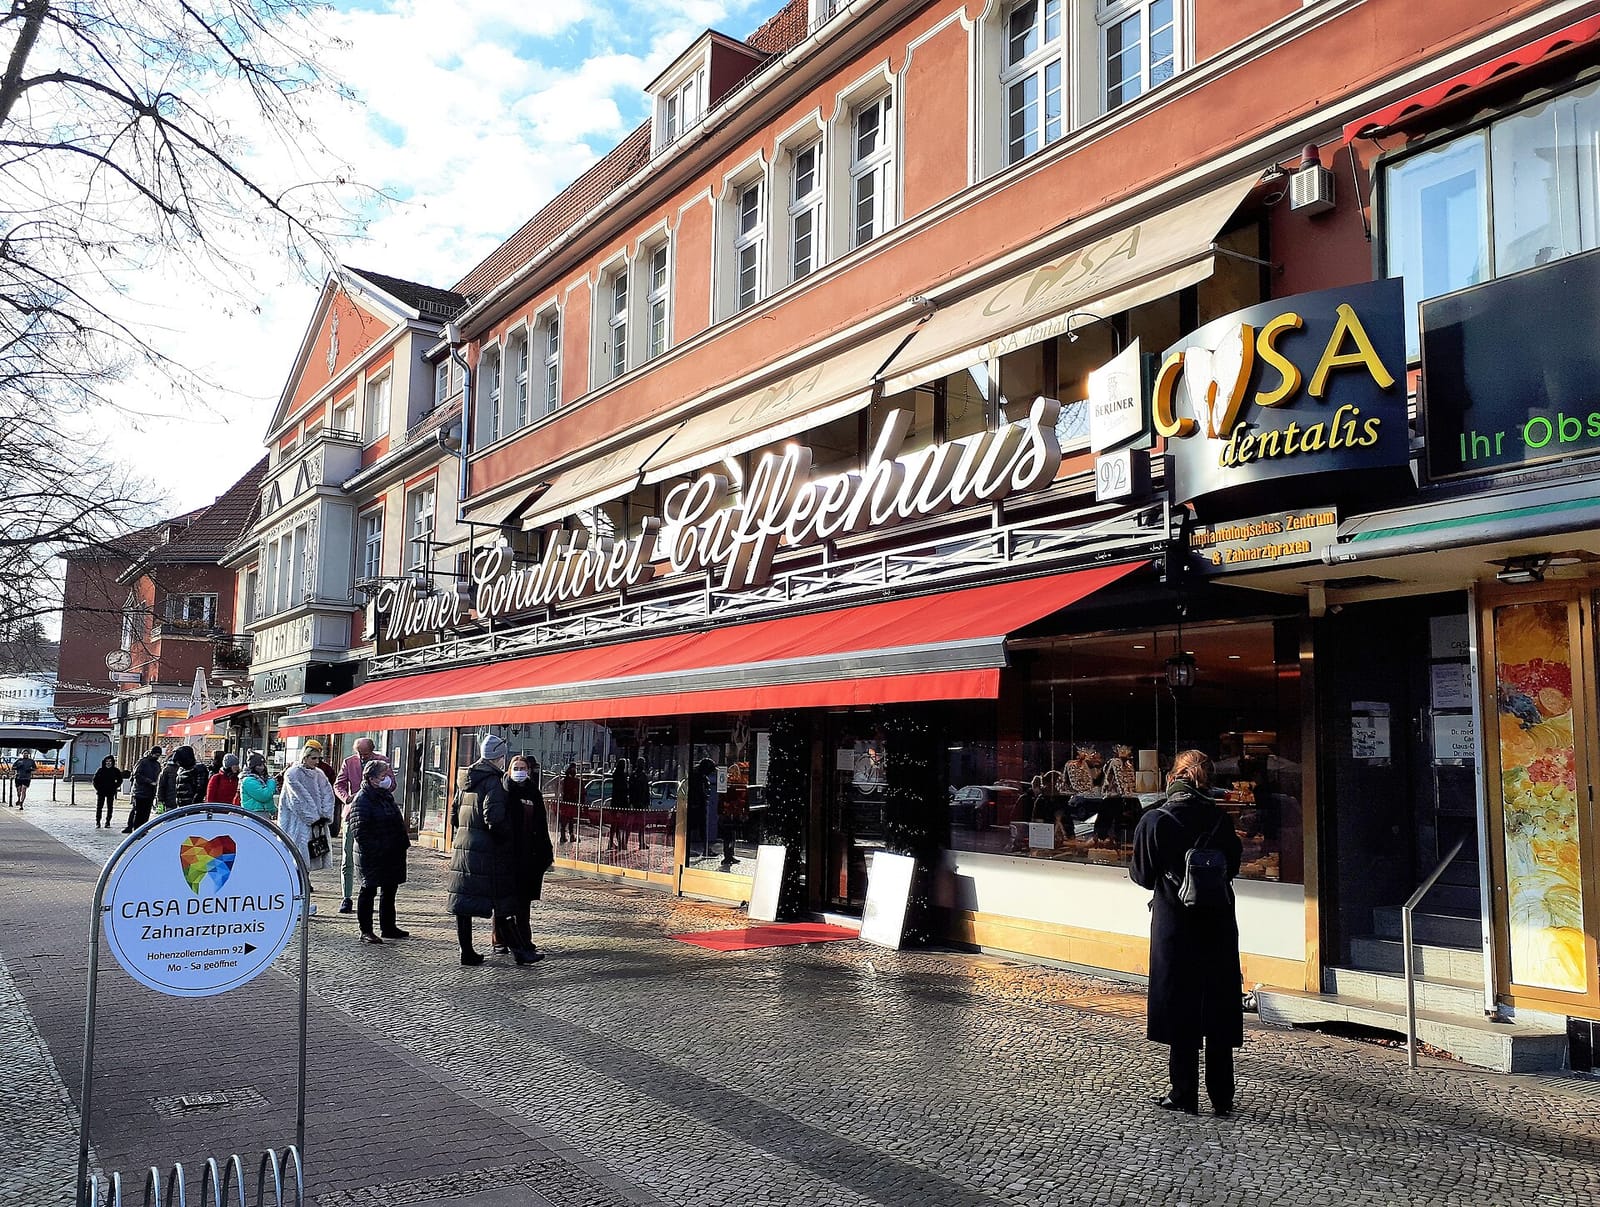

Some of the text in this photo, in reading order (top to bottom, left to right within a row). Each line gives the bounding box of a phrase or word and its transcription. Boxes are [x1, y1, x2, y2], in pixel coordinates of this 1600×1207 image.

[1024, 310, 1078, 344] dentals
[1095, 396, 1134, 418] BERLINER
[1218, 403, 1381, 468] dentalis
[1460, 412, 1600, 462] Ihr Obs
[1100, 458, 1127, 493] 92
[377, 396, 1051, 640] Wiener Conditorei Caffeehaus
[1189, 511, 1335, 548] Implantologisches Zentrum
[1211, 539, 1311, 565] & Zahnarztpraxen
[121, 894, 285, 919] CASA DENTALIS
[141, 919, 265, 940] Zahnarztpraxis
[147, 945, 243, 961] Hohenzollerndamm 92
[167, 964, 182, 973] Mo
[190, 962, 201, 971] Sa
[203, 960, 238, 972] geöffnet
